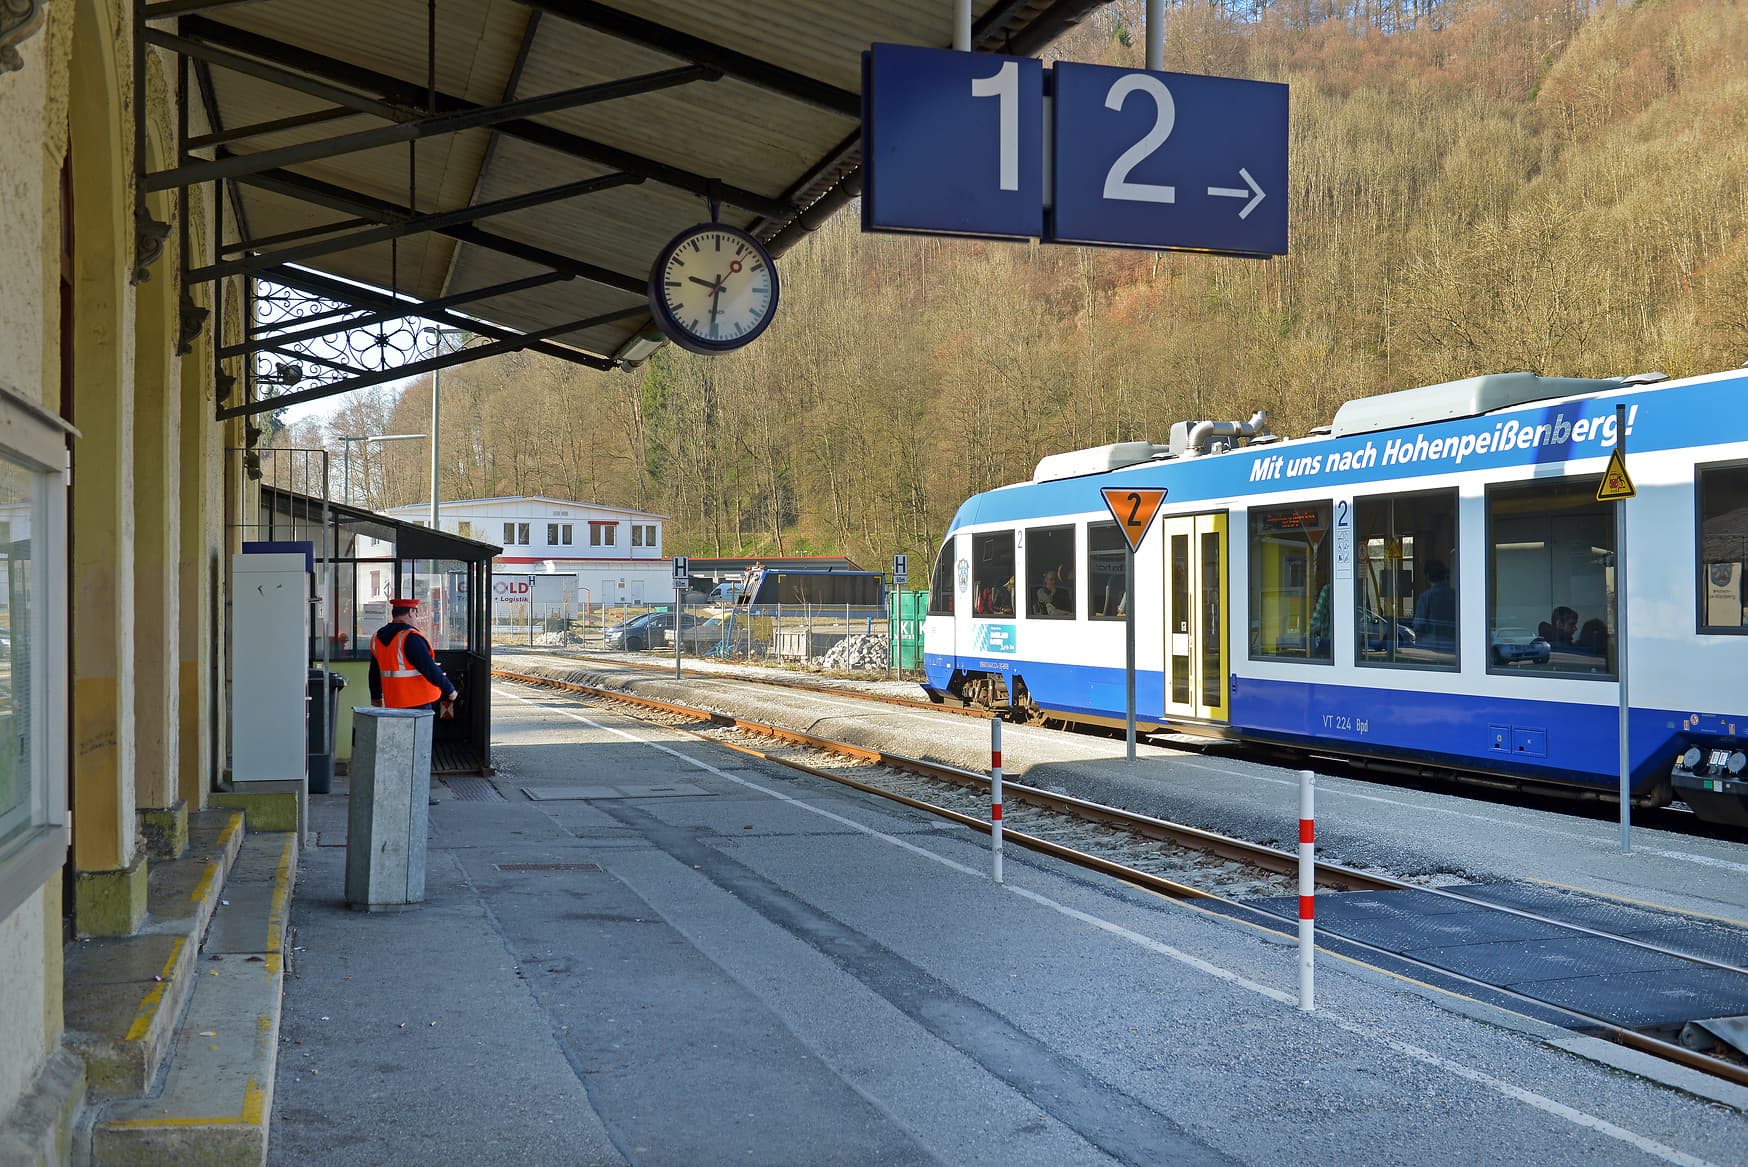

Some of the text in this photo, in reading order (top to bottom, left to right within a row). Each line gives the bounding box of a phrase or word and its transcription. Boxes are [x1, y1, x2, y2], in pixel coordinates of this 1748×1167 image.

[971, 61, 1019, 191] 1
[1103, 73, 1176, 204] 2
[1249, 455, 1284, 482] Mit
[1286, 455, 1323, 478] uns
[1325, 440, 1378, 473] nach
[1127, 492, 1142, 527] 2
[1338, 500, 1348, 527] 2
[1017, 530, 1023, 549] 2
[675, 557, 687, 577] H
[895, 556, 906, 574] H
[528, 575, 536, 586] H
[500, 595, 529, 603] Logistik
[1322, 714, 1334, 729] VT
[1336, 716, 1351, 731] 224
